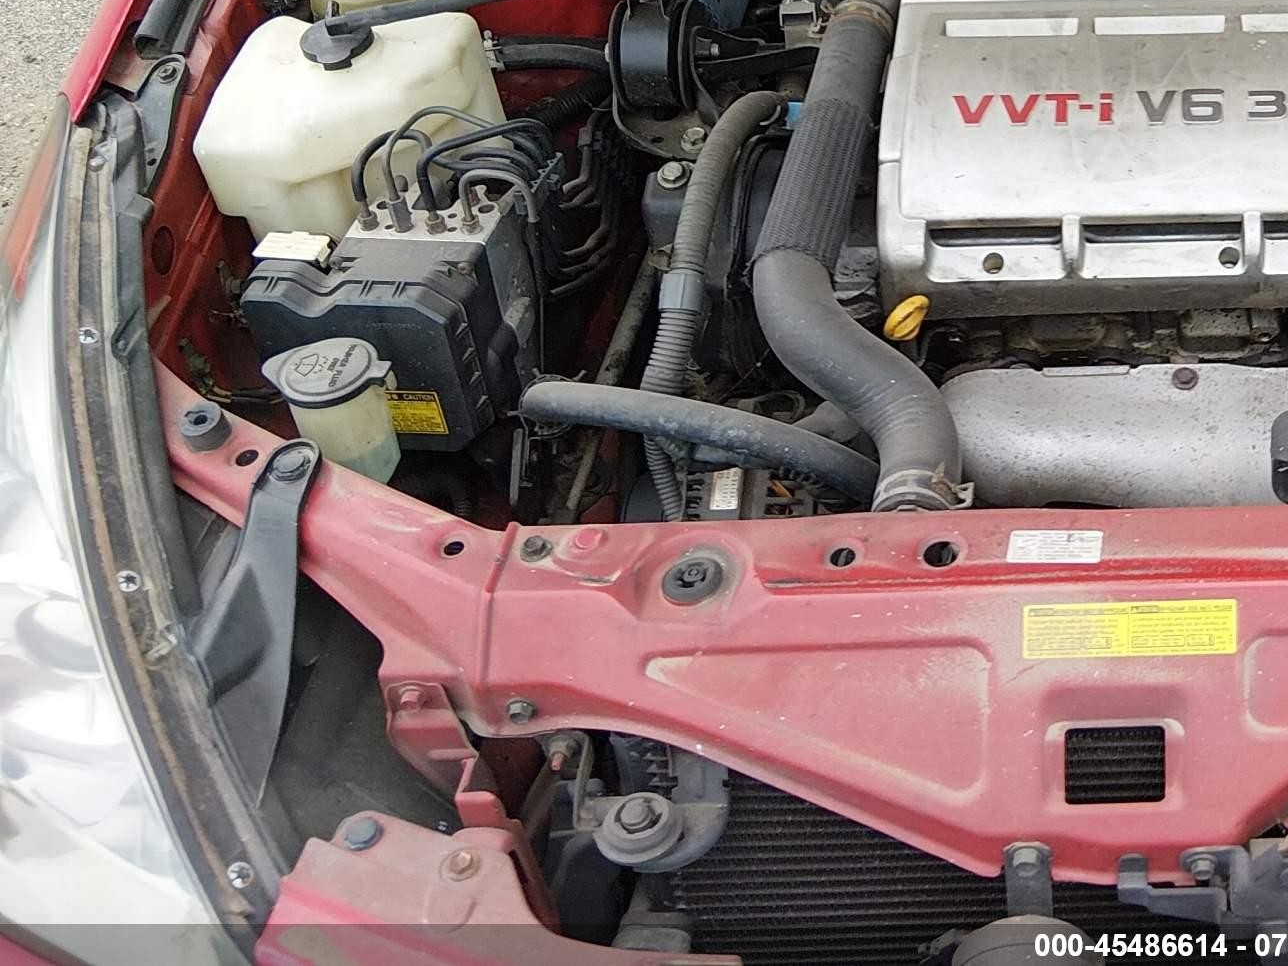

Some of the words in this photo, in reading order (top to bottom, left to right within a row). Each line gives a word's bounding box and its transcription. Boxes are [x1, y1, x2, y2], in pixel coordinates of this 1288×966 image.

[953, 91, 1113, 126] VVT-i
[1136, 88, 1226, 124] V6
[327, 369, 343, 388] FLUID
[402, 393, 435, 402] CAUTION
